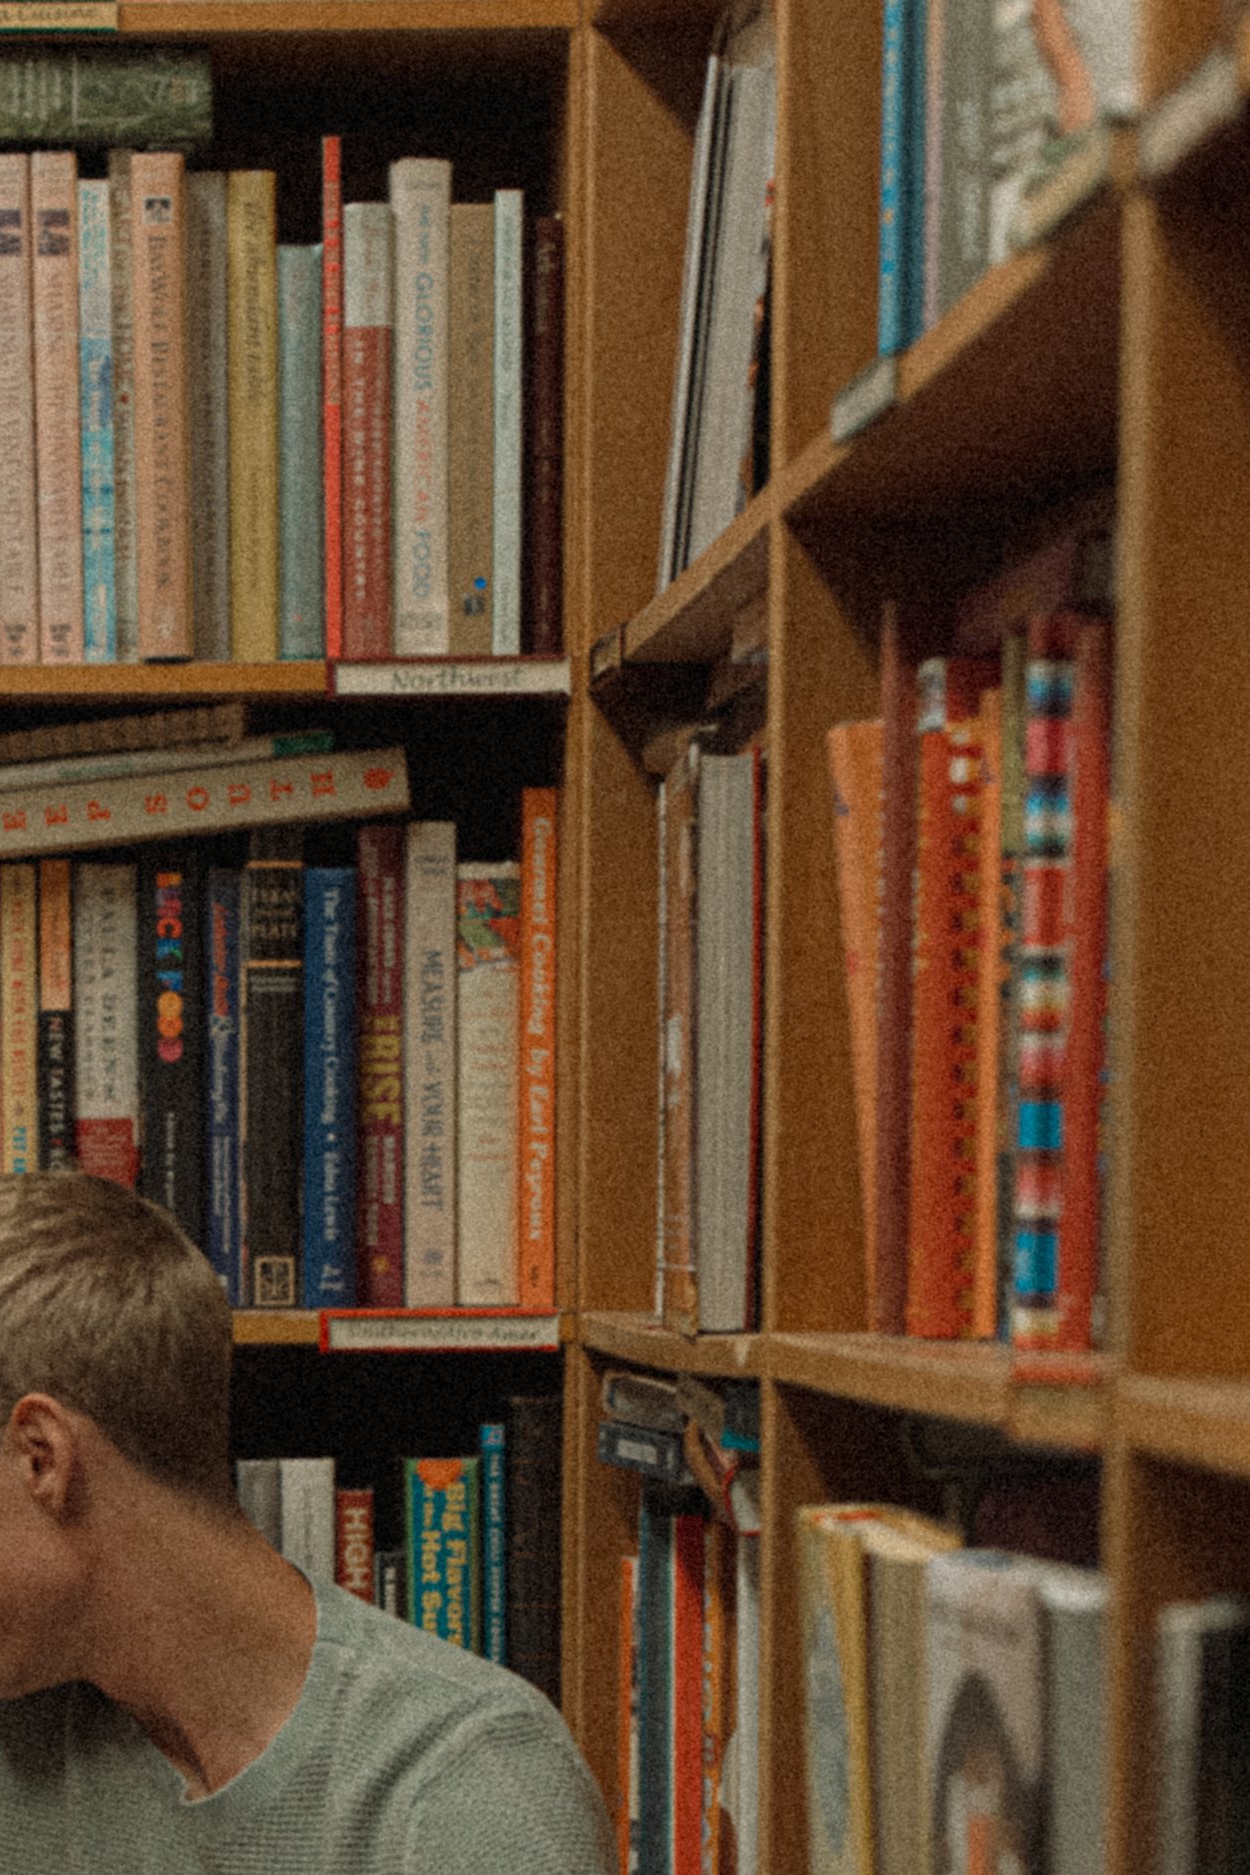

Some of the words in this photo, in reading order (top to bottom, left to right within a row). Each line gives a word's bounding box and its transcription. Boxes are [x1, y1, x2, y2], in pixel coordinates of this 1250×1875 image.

[17, 3, 98, 22] Cuisine
[412, 271, 435, 391] GLORIOUS
[412, 399, 434, 523] AMERICAN
[352, 498, 366, 600] COUNTRY
[412, 529, 434, 600] FOOD
[391, 667, 523, 690] Northwest
[144, 770, 336, 816] SOUTH
[531, 816, 551, 925] Gourmet
[100, 886, 117, 981] PAULA
[155, 870, 183, 960] BLACK
[324, 888, 338, 919] The
[322, 972, 338, 988] of
[324, 926, 338, 972] Taste
[421, 950, 443, 1044] MEASURE
[527, 932, 551, 1035] Cooking
[48, 1016, 64, 1059] NEW
[155, 969, 183, 1064] FOOD
[320, 989, 338, 1053] Country
[320, 1061, 338, 1123] Cooking
[359, 1034, 402, 1124] RISE
[526, 1048, 551, 1076] by
[48, 1067, 65, 1134] TASTES
[421, 1081, 443, 1138] YOUR
[530, 1085, 551, 1133] Earl
[324, 1151, 338, 1191] Edna
[421, 1143, 443, 1211] HEART
[526, 1143, 549, 1240] Peyroux
[324, 1197, 338, 1241] Lewis
[442, 1481, 466, 1531] Big
[343, 1506, 370, 1590] HIGH
[421, 1529, 441, 1583] Hot
[445, 1538, 468, 1650] Flavors
